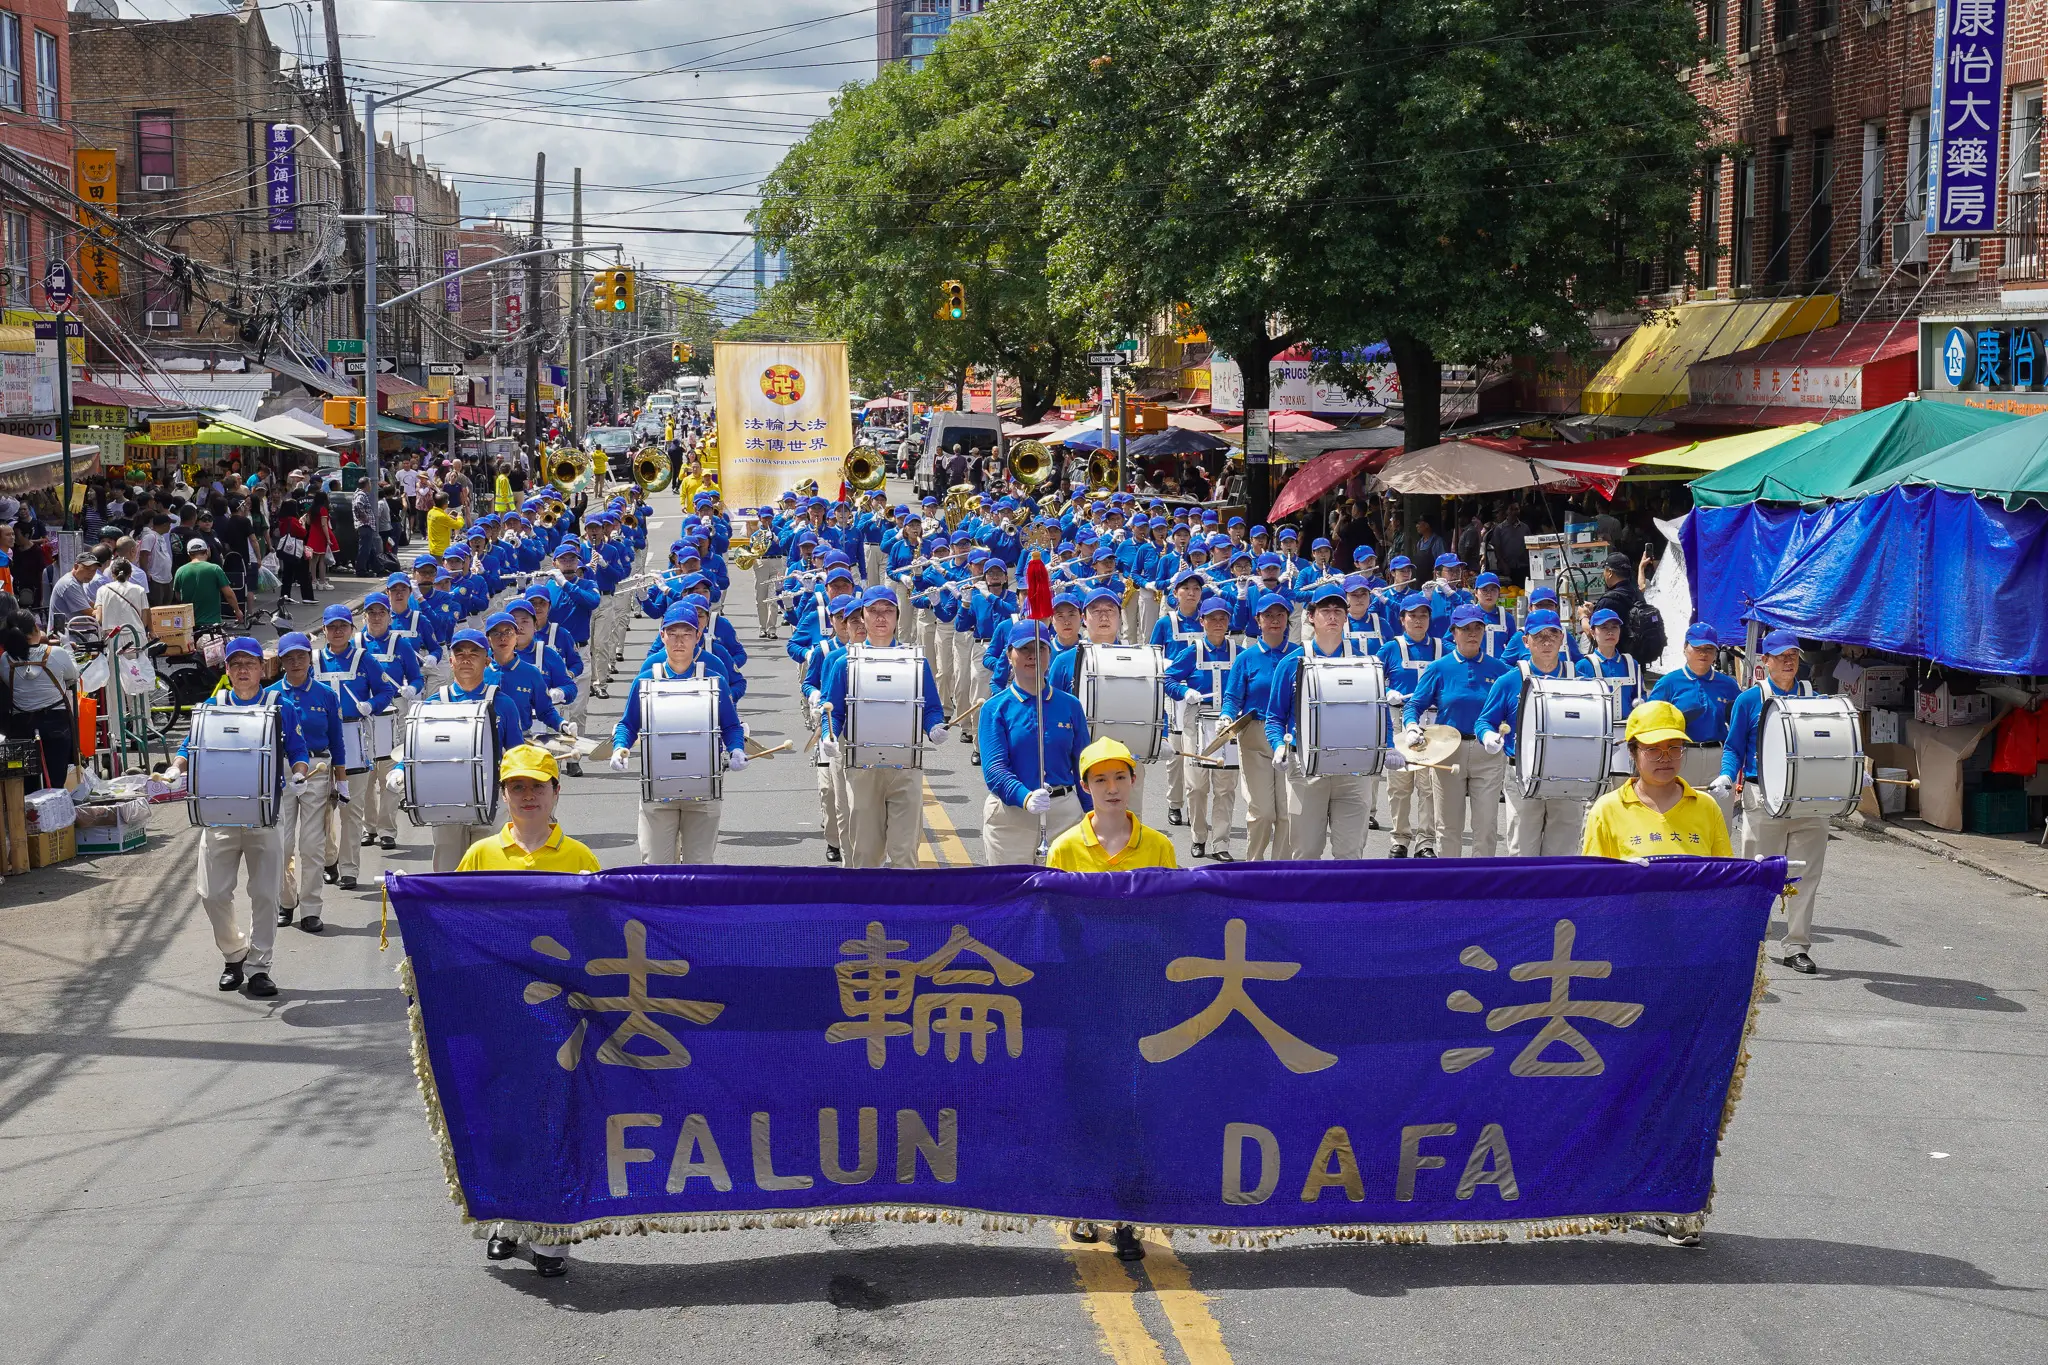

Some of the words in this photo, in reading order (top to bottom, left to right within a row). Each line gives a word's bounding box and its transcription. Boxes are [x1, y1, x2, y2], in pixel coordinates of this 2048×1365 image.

[1943, 0, 1996, 225] 康怡大藥房
[337, 341, 347, 351] 57
[1976, 326, 2048, 387] 康怡
[350, 363, 364, 371] ONE
[1279, 368, 1307, 379] DRUGS
[1735, 368, 1800, 392] 水果先生
[10, 423, 53, 436] PHOTO
[744, 418, 827, 432] 法輪大法
[745, 437, 828, 452] 洪傳世界
[802, 456, 841, 464] WORLDWIDE
[1630, 832, 1700, 845] 法輪大法
[523, 919, 1645, 1077] 法輪大法
[606, 1107, 957, 1197] FALUN
[1222, 1122, 1520, 1205] DAFA
